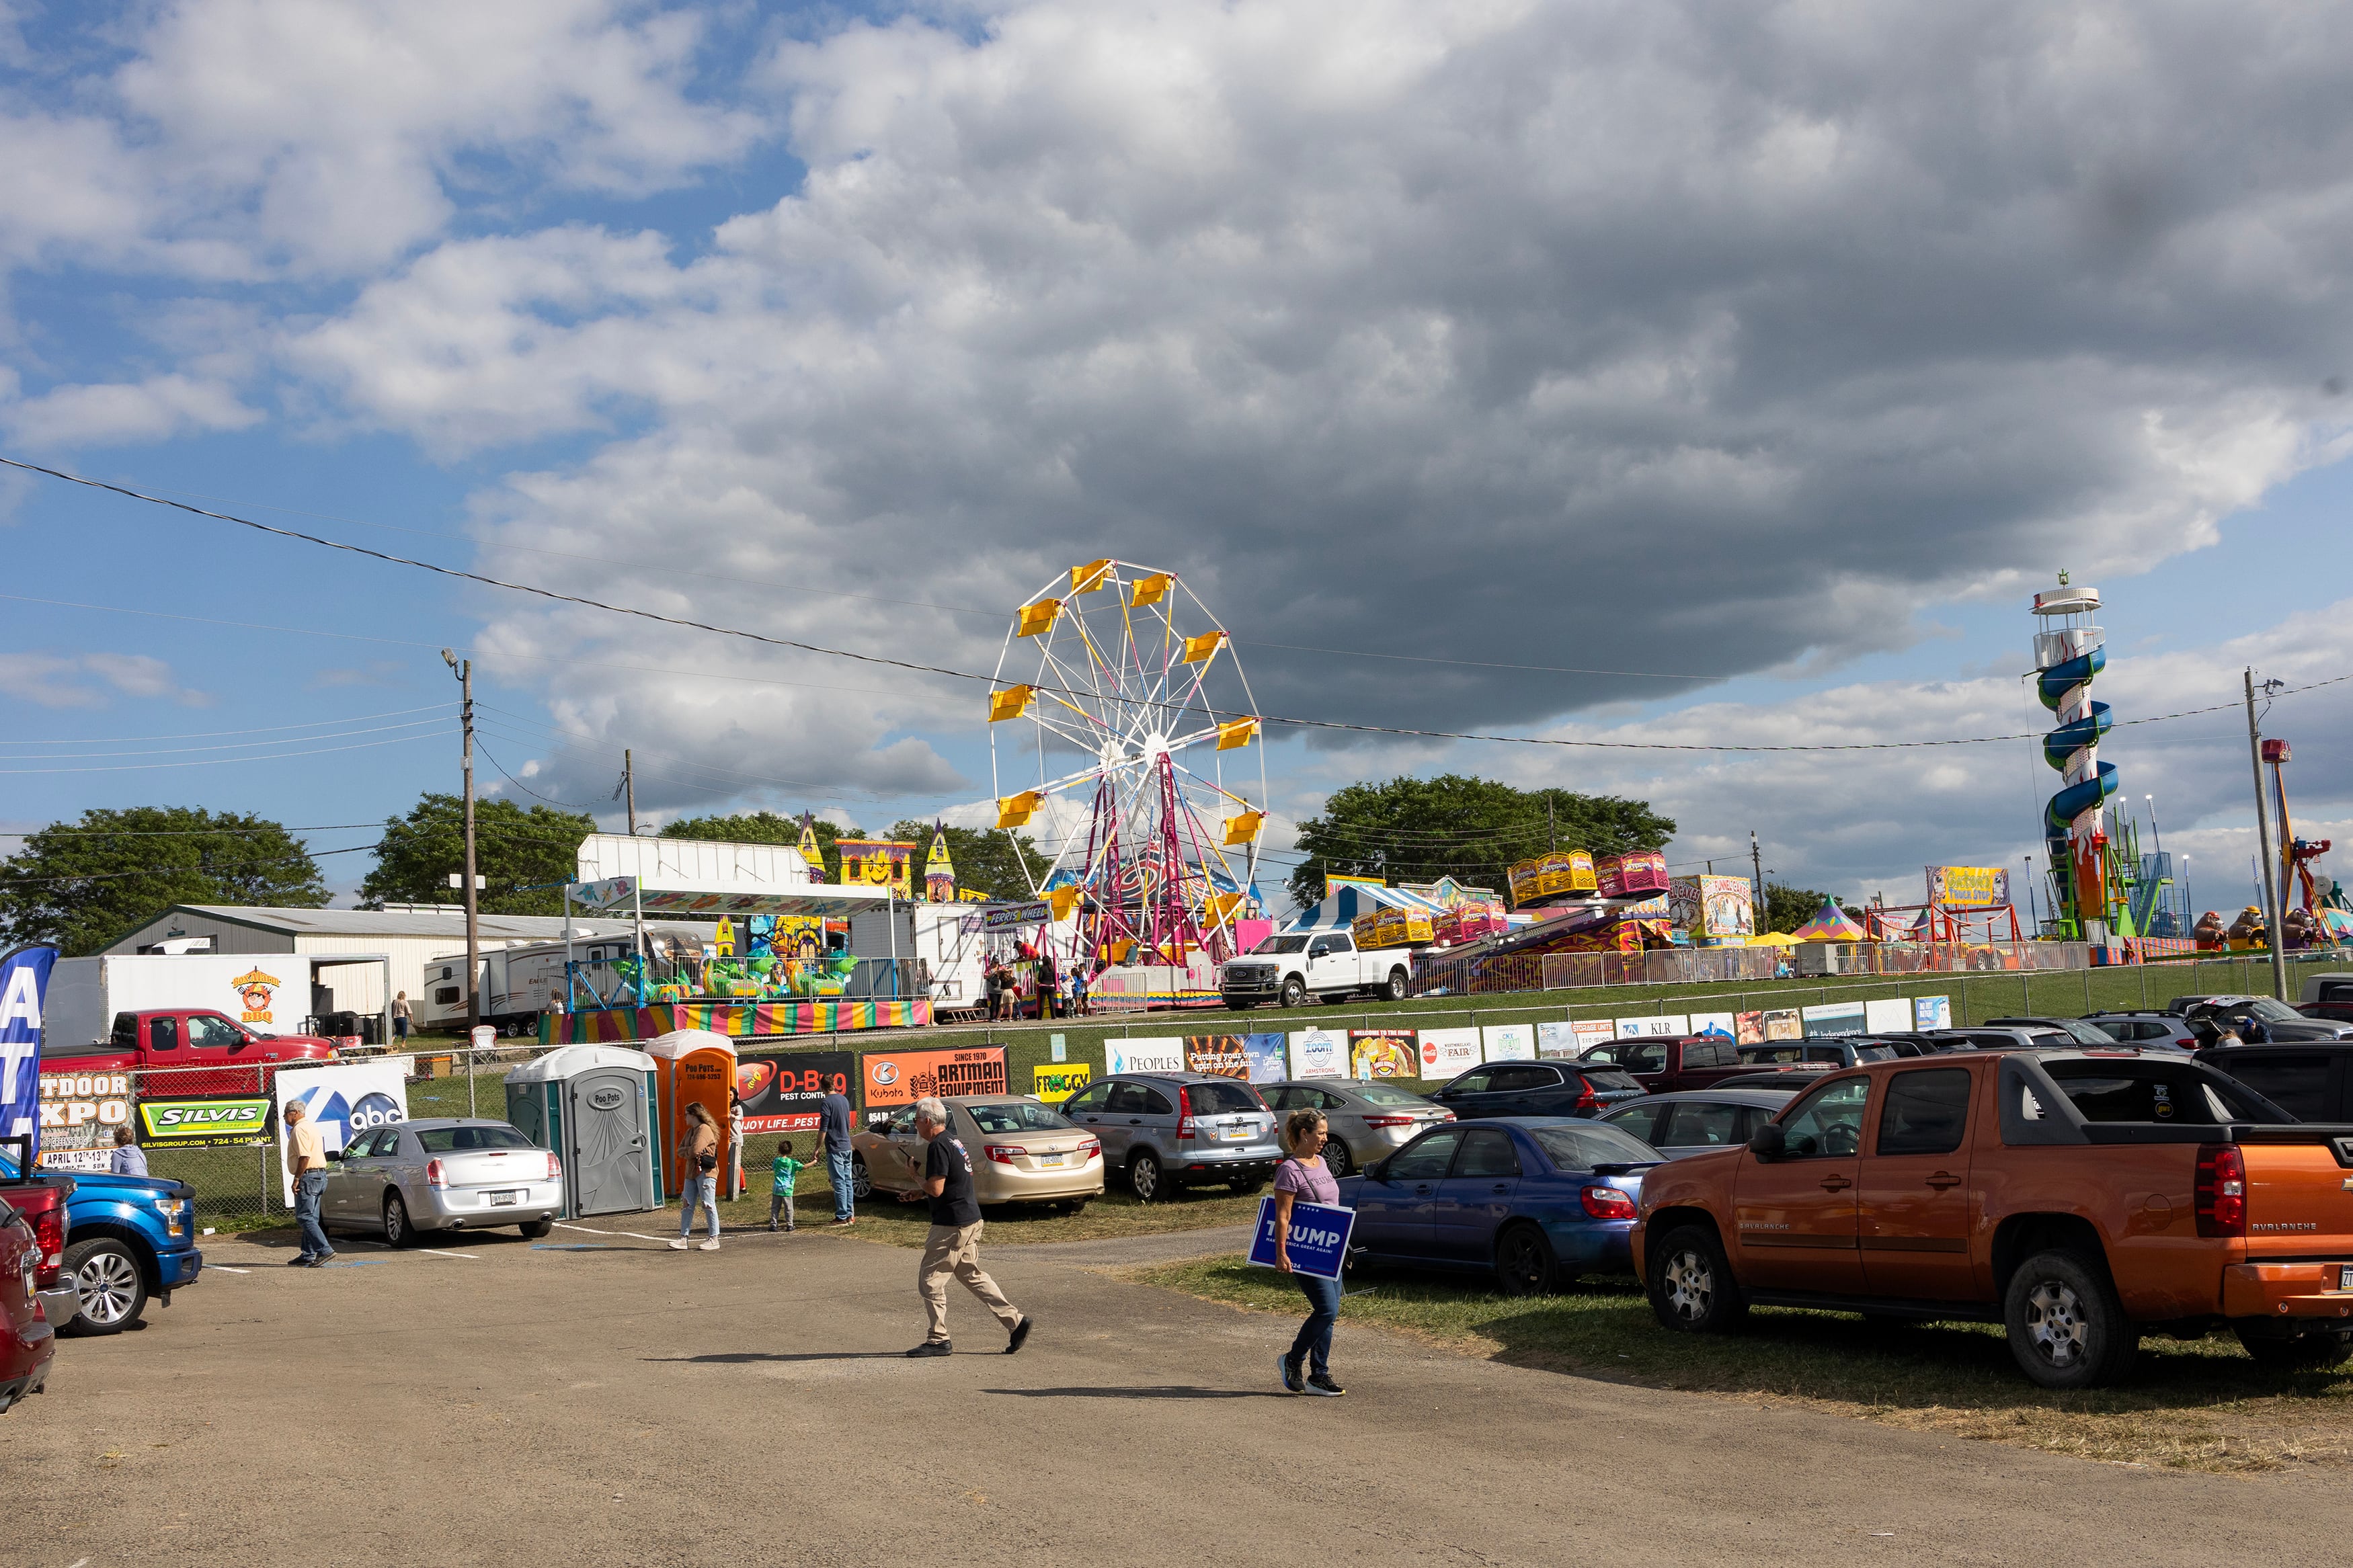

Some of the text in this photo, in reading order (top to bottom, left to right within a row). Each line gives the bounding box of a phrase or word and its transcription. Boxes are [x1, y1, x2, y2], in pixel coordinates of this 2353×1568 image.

[1678, 886, 1701, 902] CAKES
[1714, 879, 1732, 893] FUNNEL
[1732, 880, 1749, 901] CAKES
[1948, 889, 1990, 900] TRUCK STOP
[991, 907, 1045, 923] FERRIS WHEEL
[233, 971, 280, 988] Box Alarm
[241, 1011, 273, 1024] BBQ
[1651, 1022, 1671, 1034] KLR
[1305, 1042, 1332, 1053] zoom
[1447, 1048, 1470, 1057] FAIR
[955, 1052, 986, 1061] SINCE 1970
[1191, 1052, 1222, 1062] Putting
[1223, 1053, 1242, 1061] your
[1129, 1056, 1179, 1071] PEOPLES
[1194, 1062, 1213, 1072] spin
[1226, 1059, 1236, 1067] the
[1238, 1058, 1256, 1067] fun.
[938, 1061, 1003, 1083] ARTMAN
[40, 1075, 128, 1098] TDOOR
[780, 1070, 846, 1096] D-Bg
[939, 1079, 1004, 1098] EQUIPMENT
[595, 1093, 620, 1103] Poo Pots
[781, 1093, 799, 1101] PEST
[871, 1087, 903, 1099] Kubota
[40, 1100, 128, 1127] XPO
[157, 1107, 260, 1126] SILVIS
[349, 1105, 403, 1130] abc
[869, 1112, 881, 1122] 854
[739, 1120, 764, 1130] NJOY
[43, 1137, 87, 1147] OF GREENSBURG
[141, 1140, 206, 1148] SILVISGROUP.COM
[47, 1153, 71, 1165] APRIL
[2252, 1223, 2317, 1231] AVALANCHE
